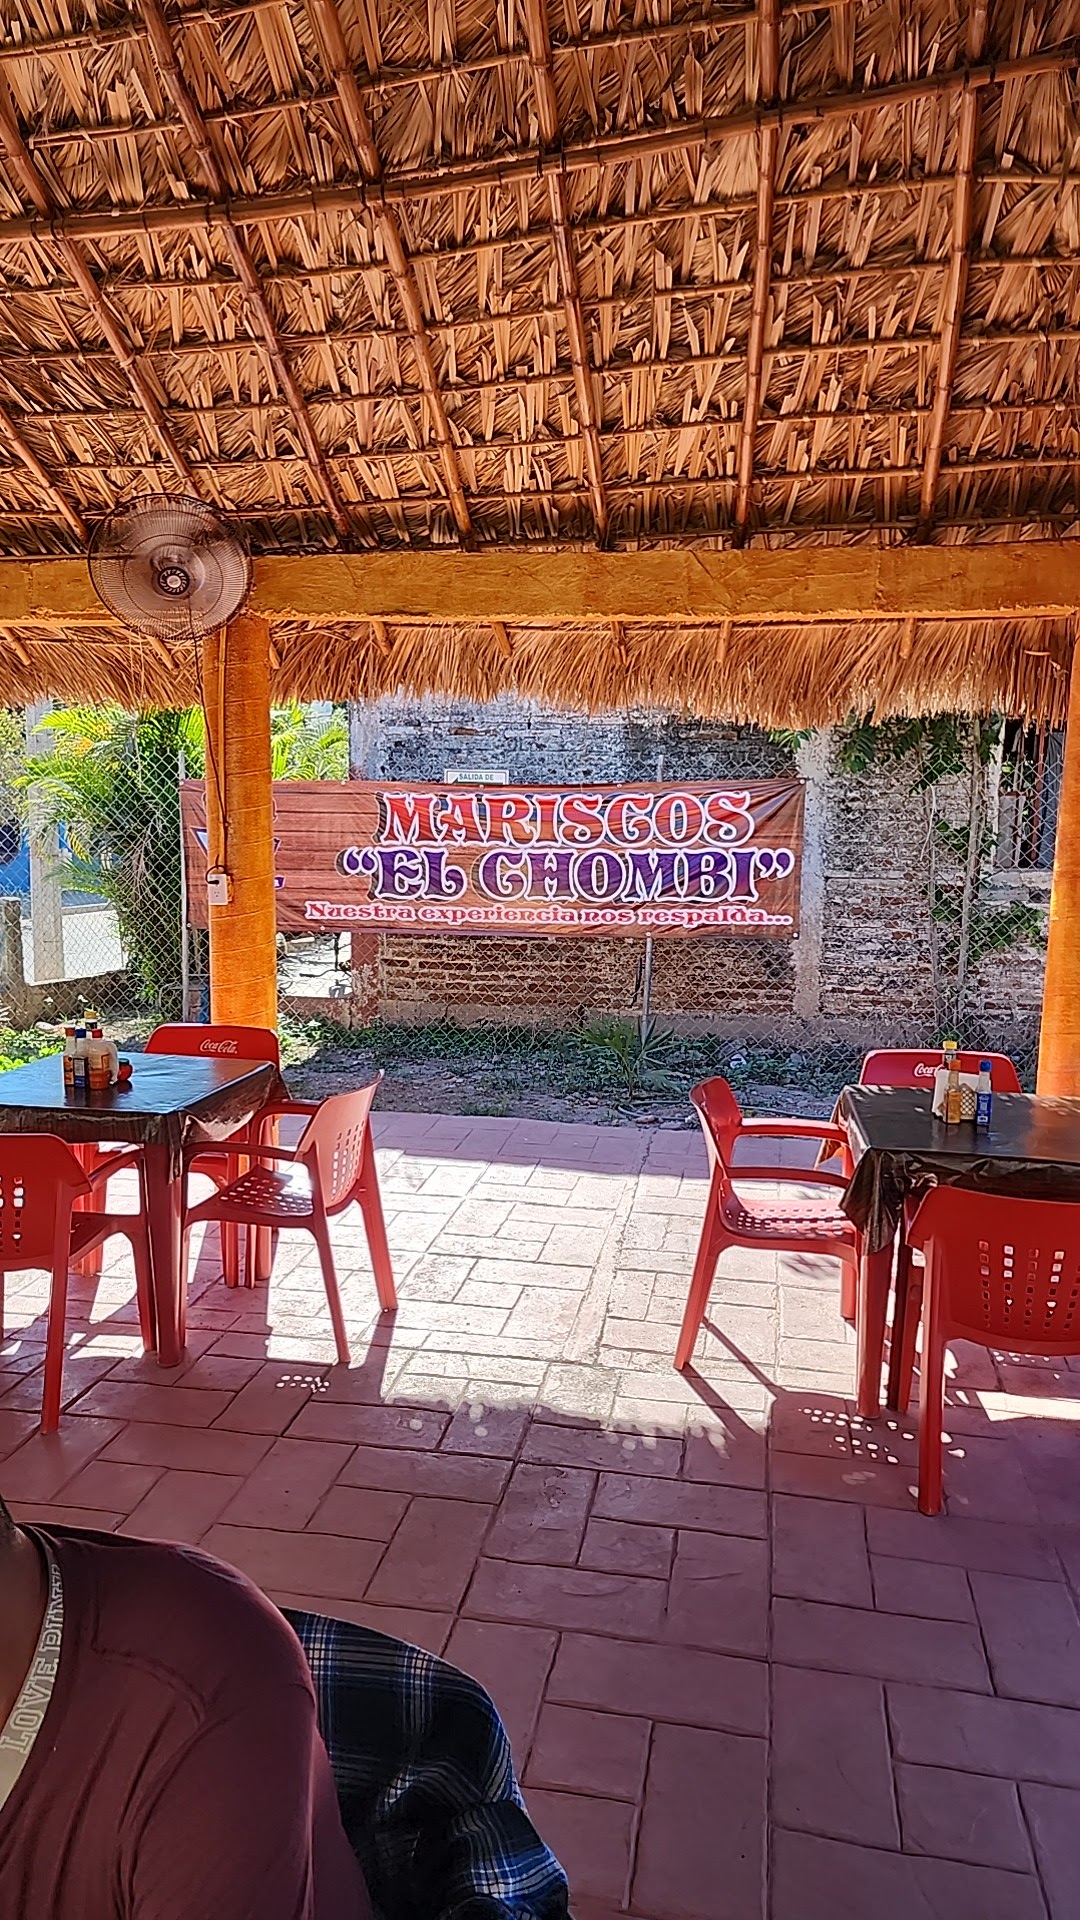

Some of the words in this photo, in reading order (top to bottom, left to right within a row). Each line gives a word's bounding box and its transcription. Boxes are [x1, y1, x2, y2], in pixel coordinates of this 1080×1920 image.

[377, 791, 755, 848] MARISCOS
[306, 902, 414, 921] Nuestra
[419, 904, 577, 925] experiencia
[581, 908, 634, 923] nos
[638, 905, 793, 928] respalda...
[0, 1657, 59, 1754] LOVE
